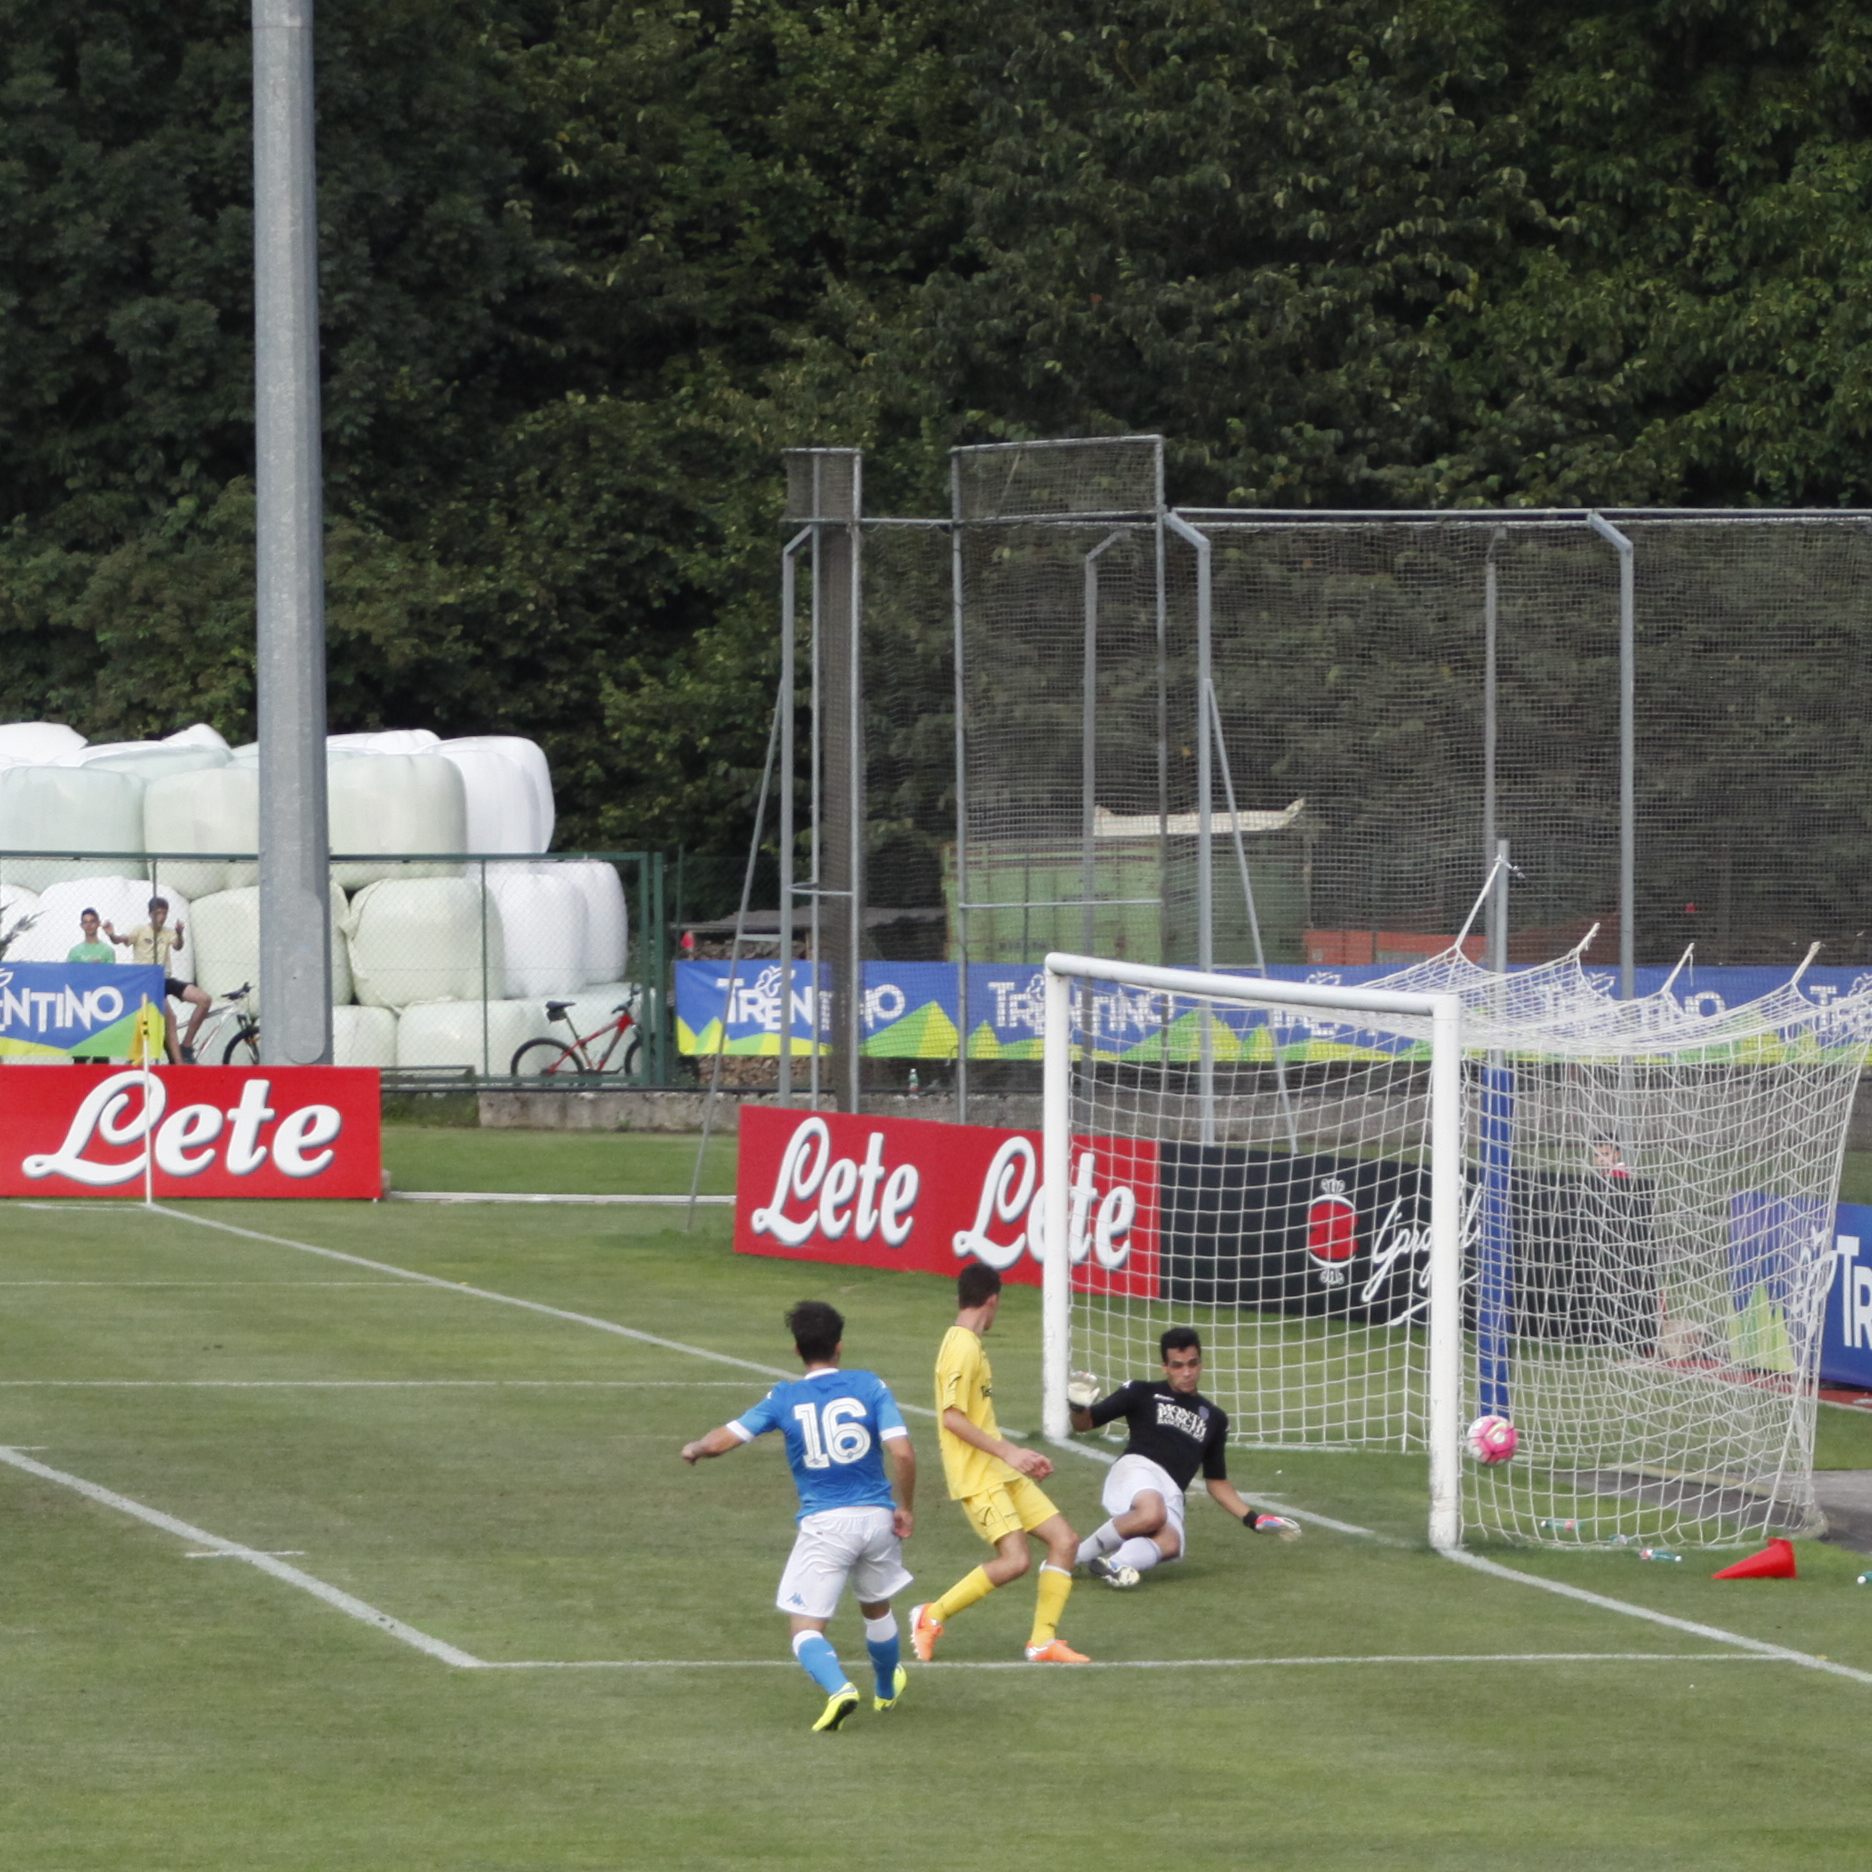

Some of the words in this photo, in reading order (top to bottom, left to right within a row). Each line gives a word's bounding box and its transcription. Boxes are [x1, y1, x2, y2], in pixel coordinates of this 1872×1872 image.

[21, 1069, 342, 1186] Lete
[751, 1116, 920, 1247] Lete
[794, 1397, 871, 1469] 16
